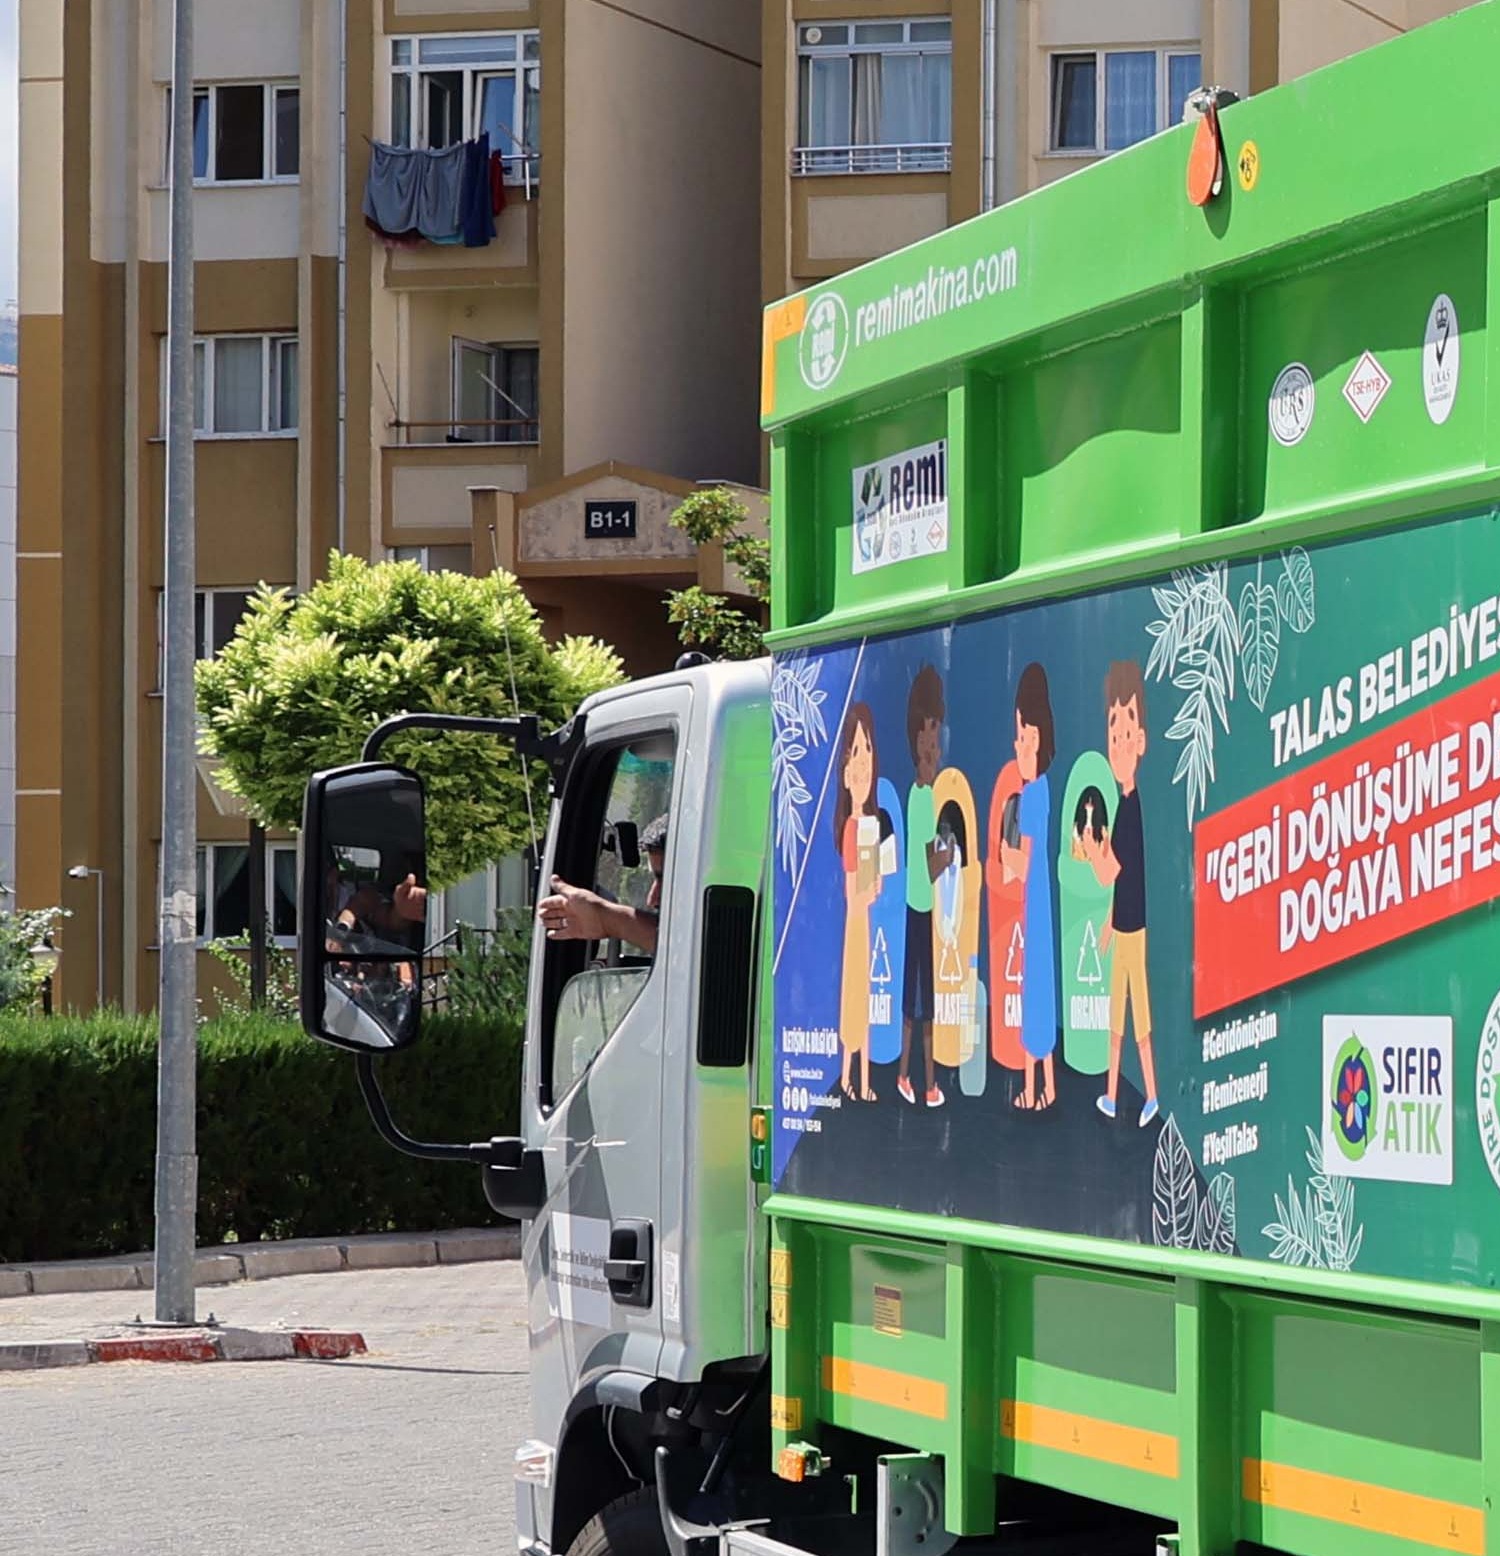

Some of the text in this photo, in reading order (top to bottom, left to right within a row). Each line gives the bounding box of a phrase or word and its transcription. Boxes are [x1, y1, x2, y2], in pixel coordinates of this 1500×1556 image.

[856, 246, 1017, 346] remimakina.com
[1352, 377, 1382, 396] TSE-HYB
[889, 440, 945, 515] Remi
[590, 511, 630, 528] B1-1
[1270, 676, 1353, 768] TALAS
[1206, 806, 1280, 903] "GERİ
[1288, 734, 1460, 874] DÖNÜŞÜME
[1280, 843, 1403, 953] DOĞAYA
[1203, 1011, 1278, 1063] #Geridönüşüm
[1203, 1062, 1269, 1114] #Temizenerji
[1383, 1047, 1442, 1095] SIFIR
[1203, 1122, 1259, 1166] #YeşilTalas
[1383, 1101, 1443, 1155] ATIK
